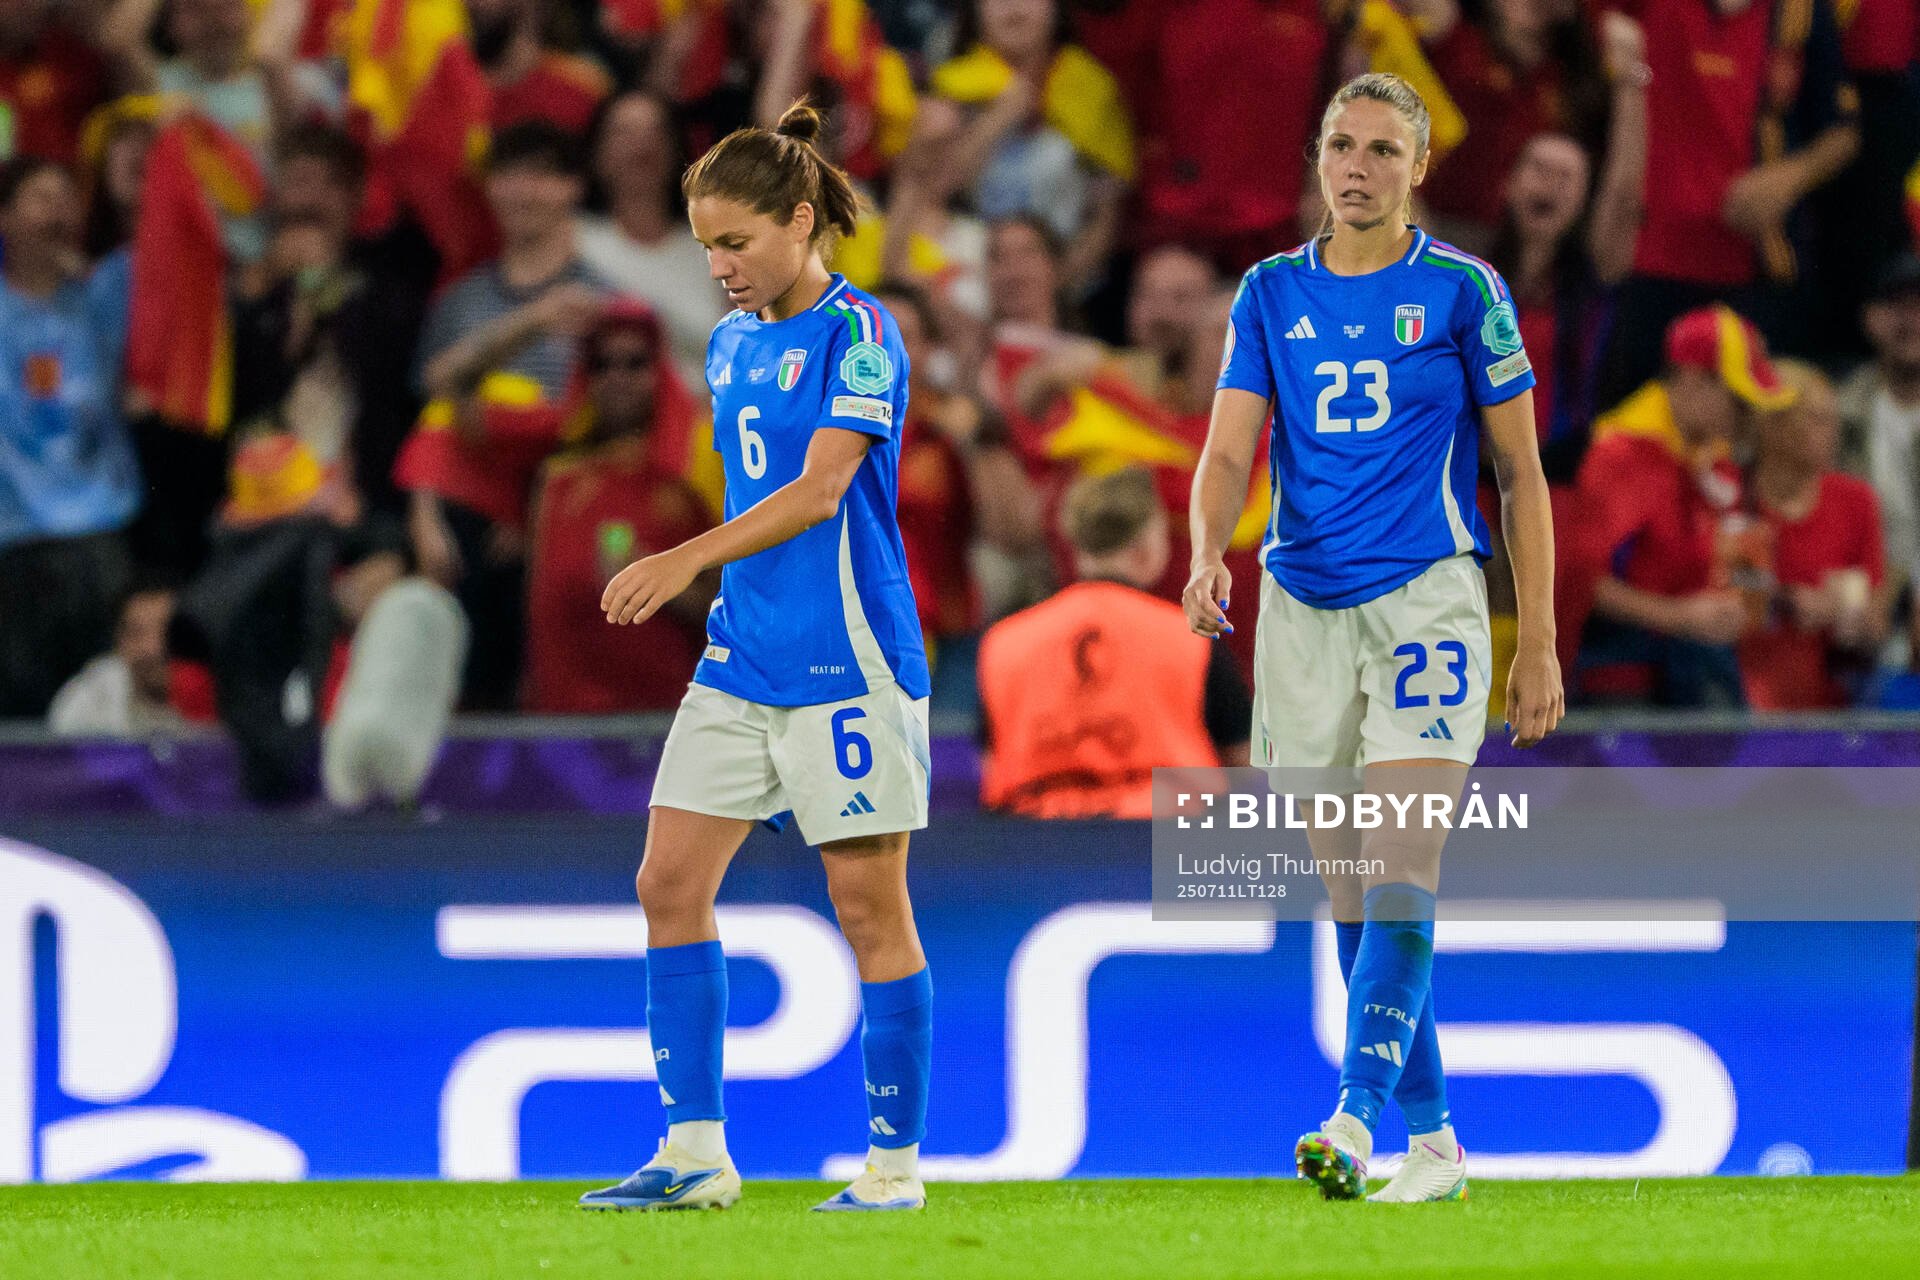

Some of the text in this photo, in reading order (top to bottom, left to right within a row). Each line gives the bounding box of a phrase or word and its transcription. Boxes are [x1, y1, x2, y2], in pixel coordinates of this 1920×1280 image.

[1397, 308, 1422, 317] ITALIA
[1314, 359, 1392, 433] 23
[737, 405, 767, 480] 6
[1393, 640, 1468, 709] 23
[831, 706, 873, 780] 6
